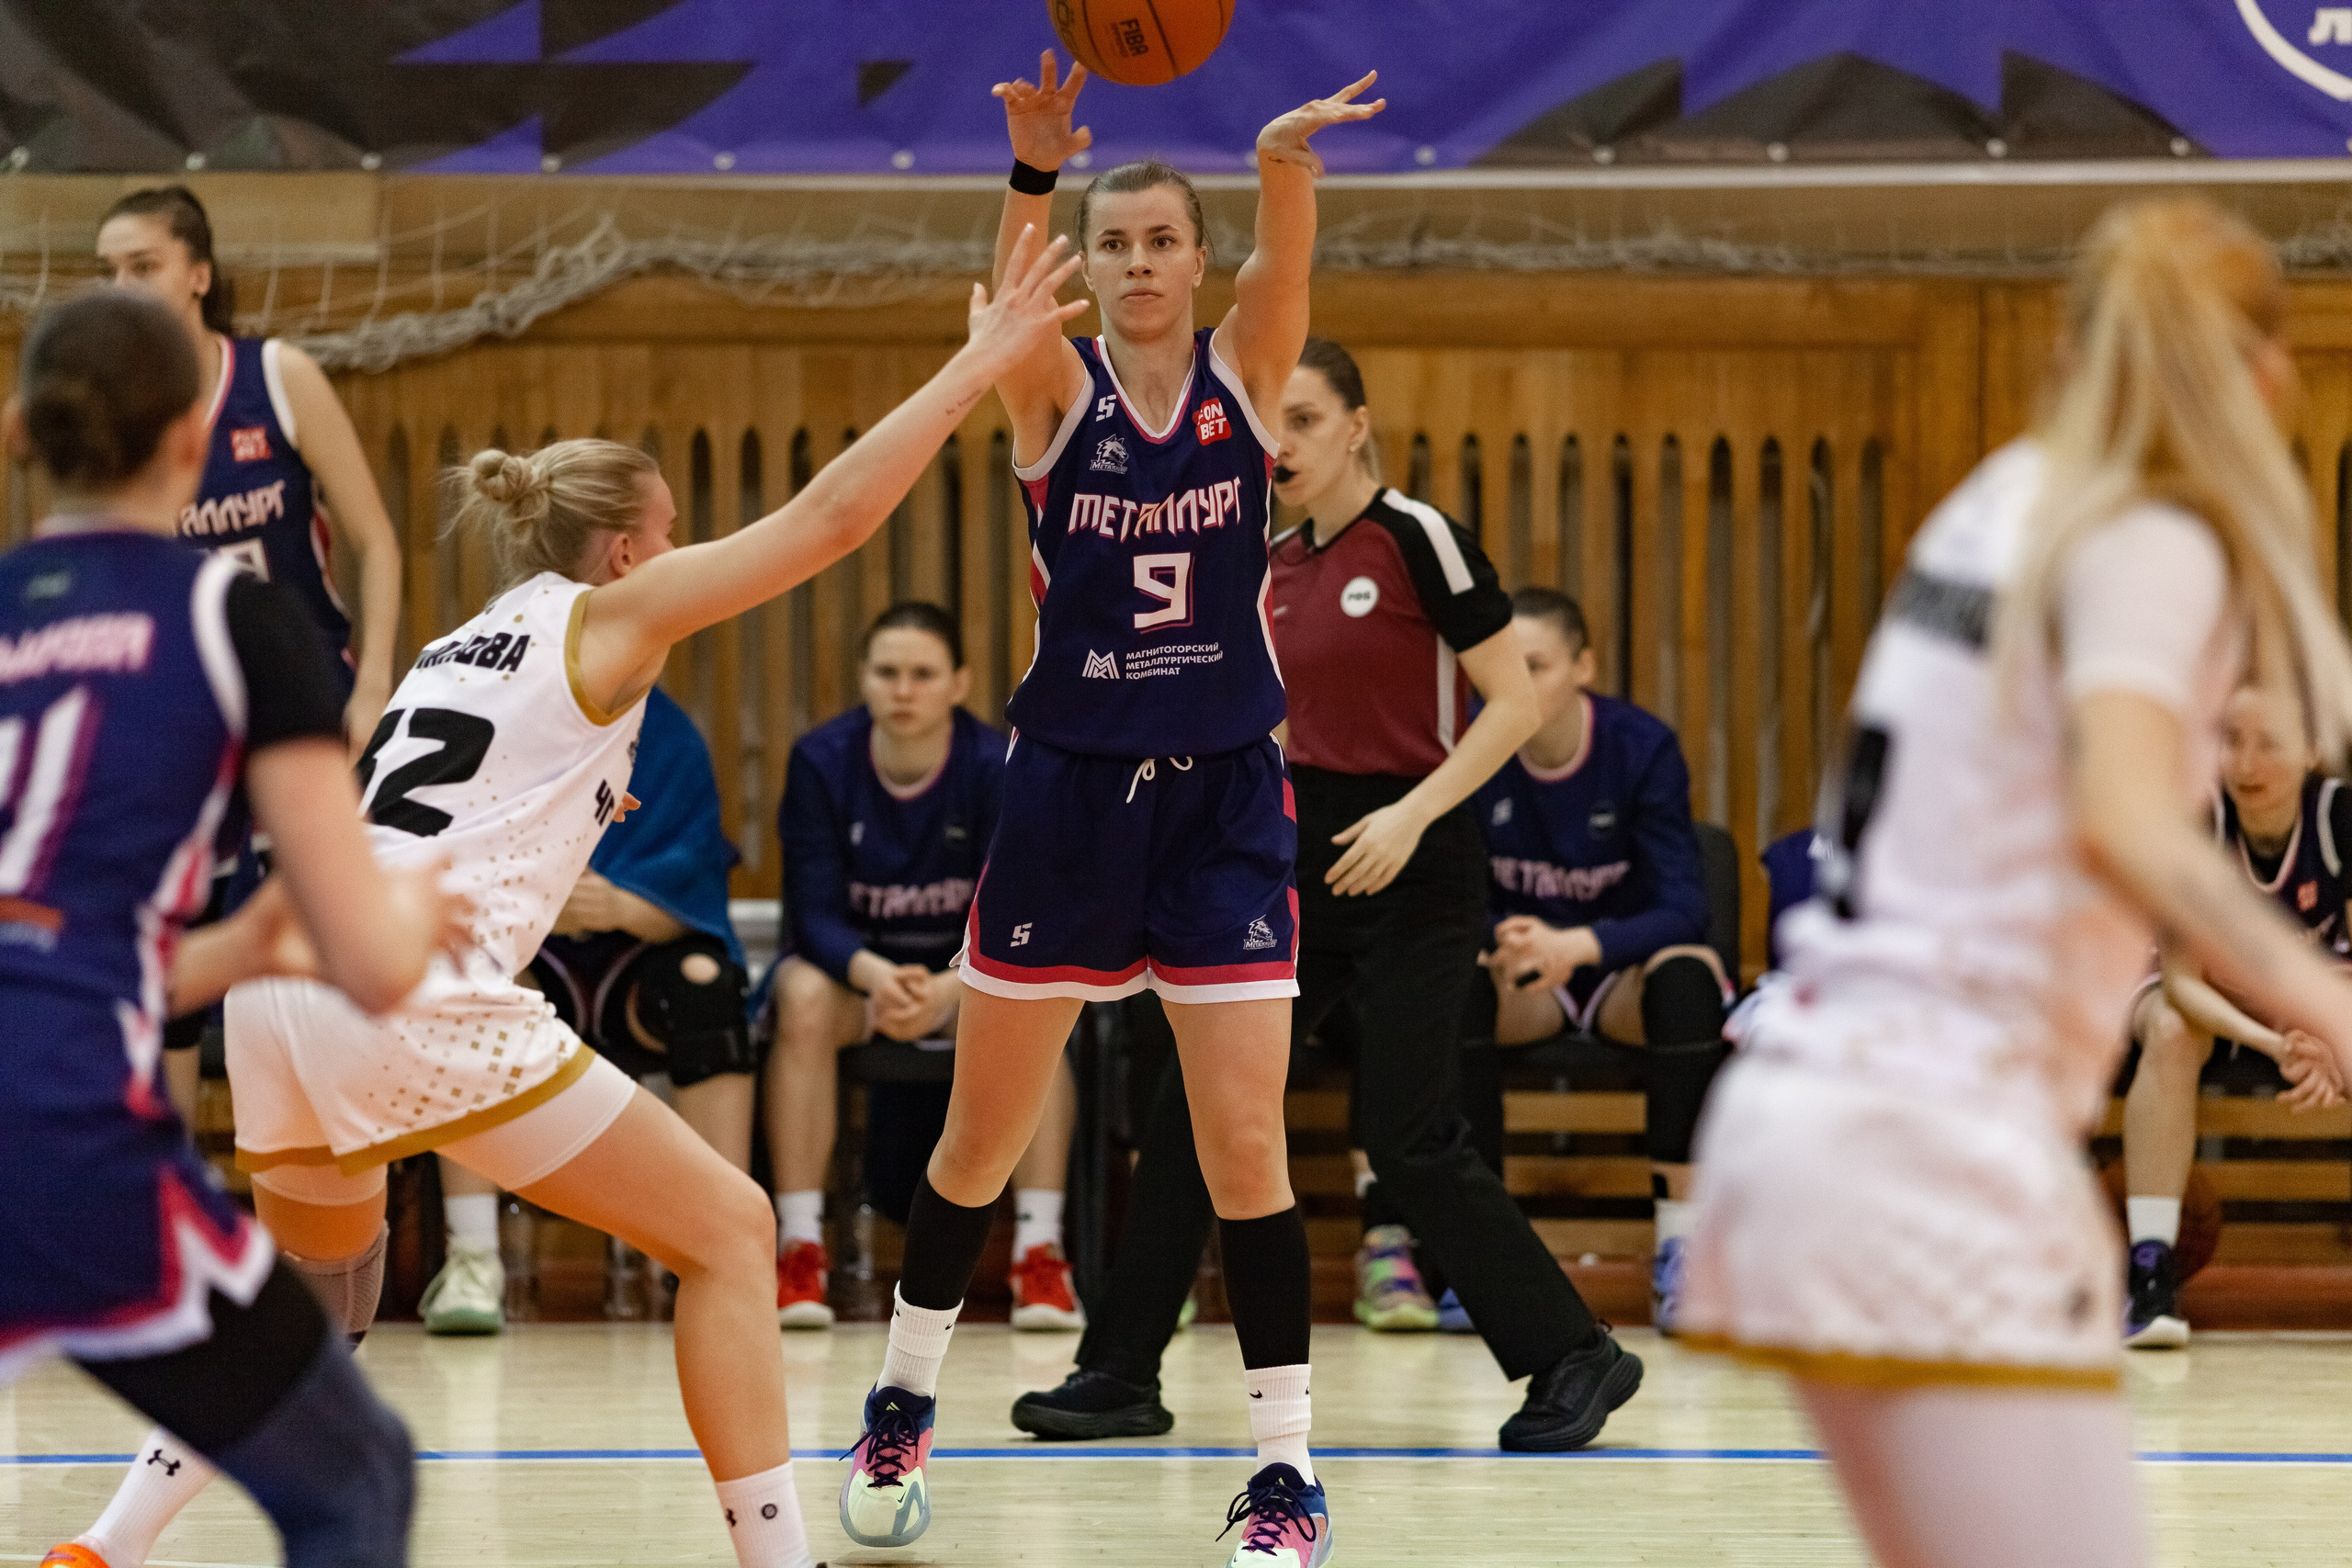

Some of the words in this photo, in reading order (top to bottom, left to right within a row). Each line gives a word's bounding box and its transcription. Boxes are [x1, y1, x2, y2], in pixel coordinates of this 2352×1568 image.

[1119, 18, 1148, 56] FIBA
[1200, 417, 1227, 441] BET
[1068, 476, 1241, 544] МЕТАЛЛУРГ
[1133, 551, 1195, 635] 9
[1125, 642, 1219, 660] МАГНИТОГОРСКИЙ
[1125, 651, 1224, 671] МЕТАЛЛУРГИЧЕСКИЙ
[1125, 667, 1181, 680] КОМБИНАТ
